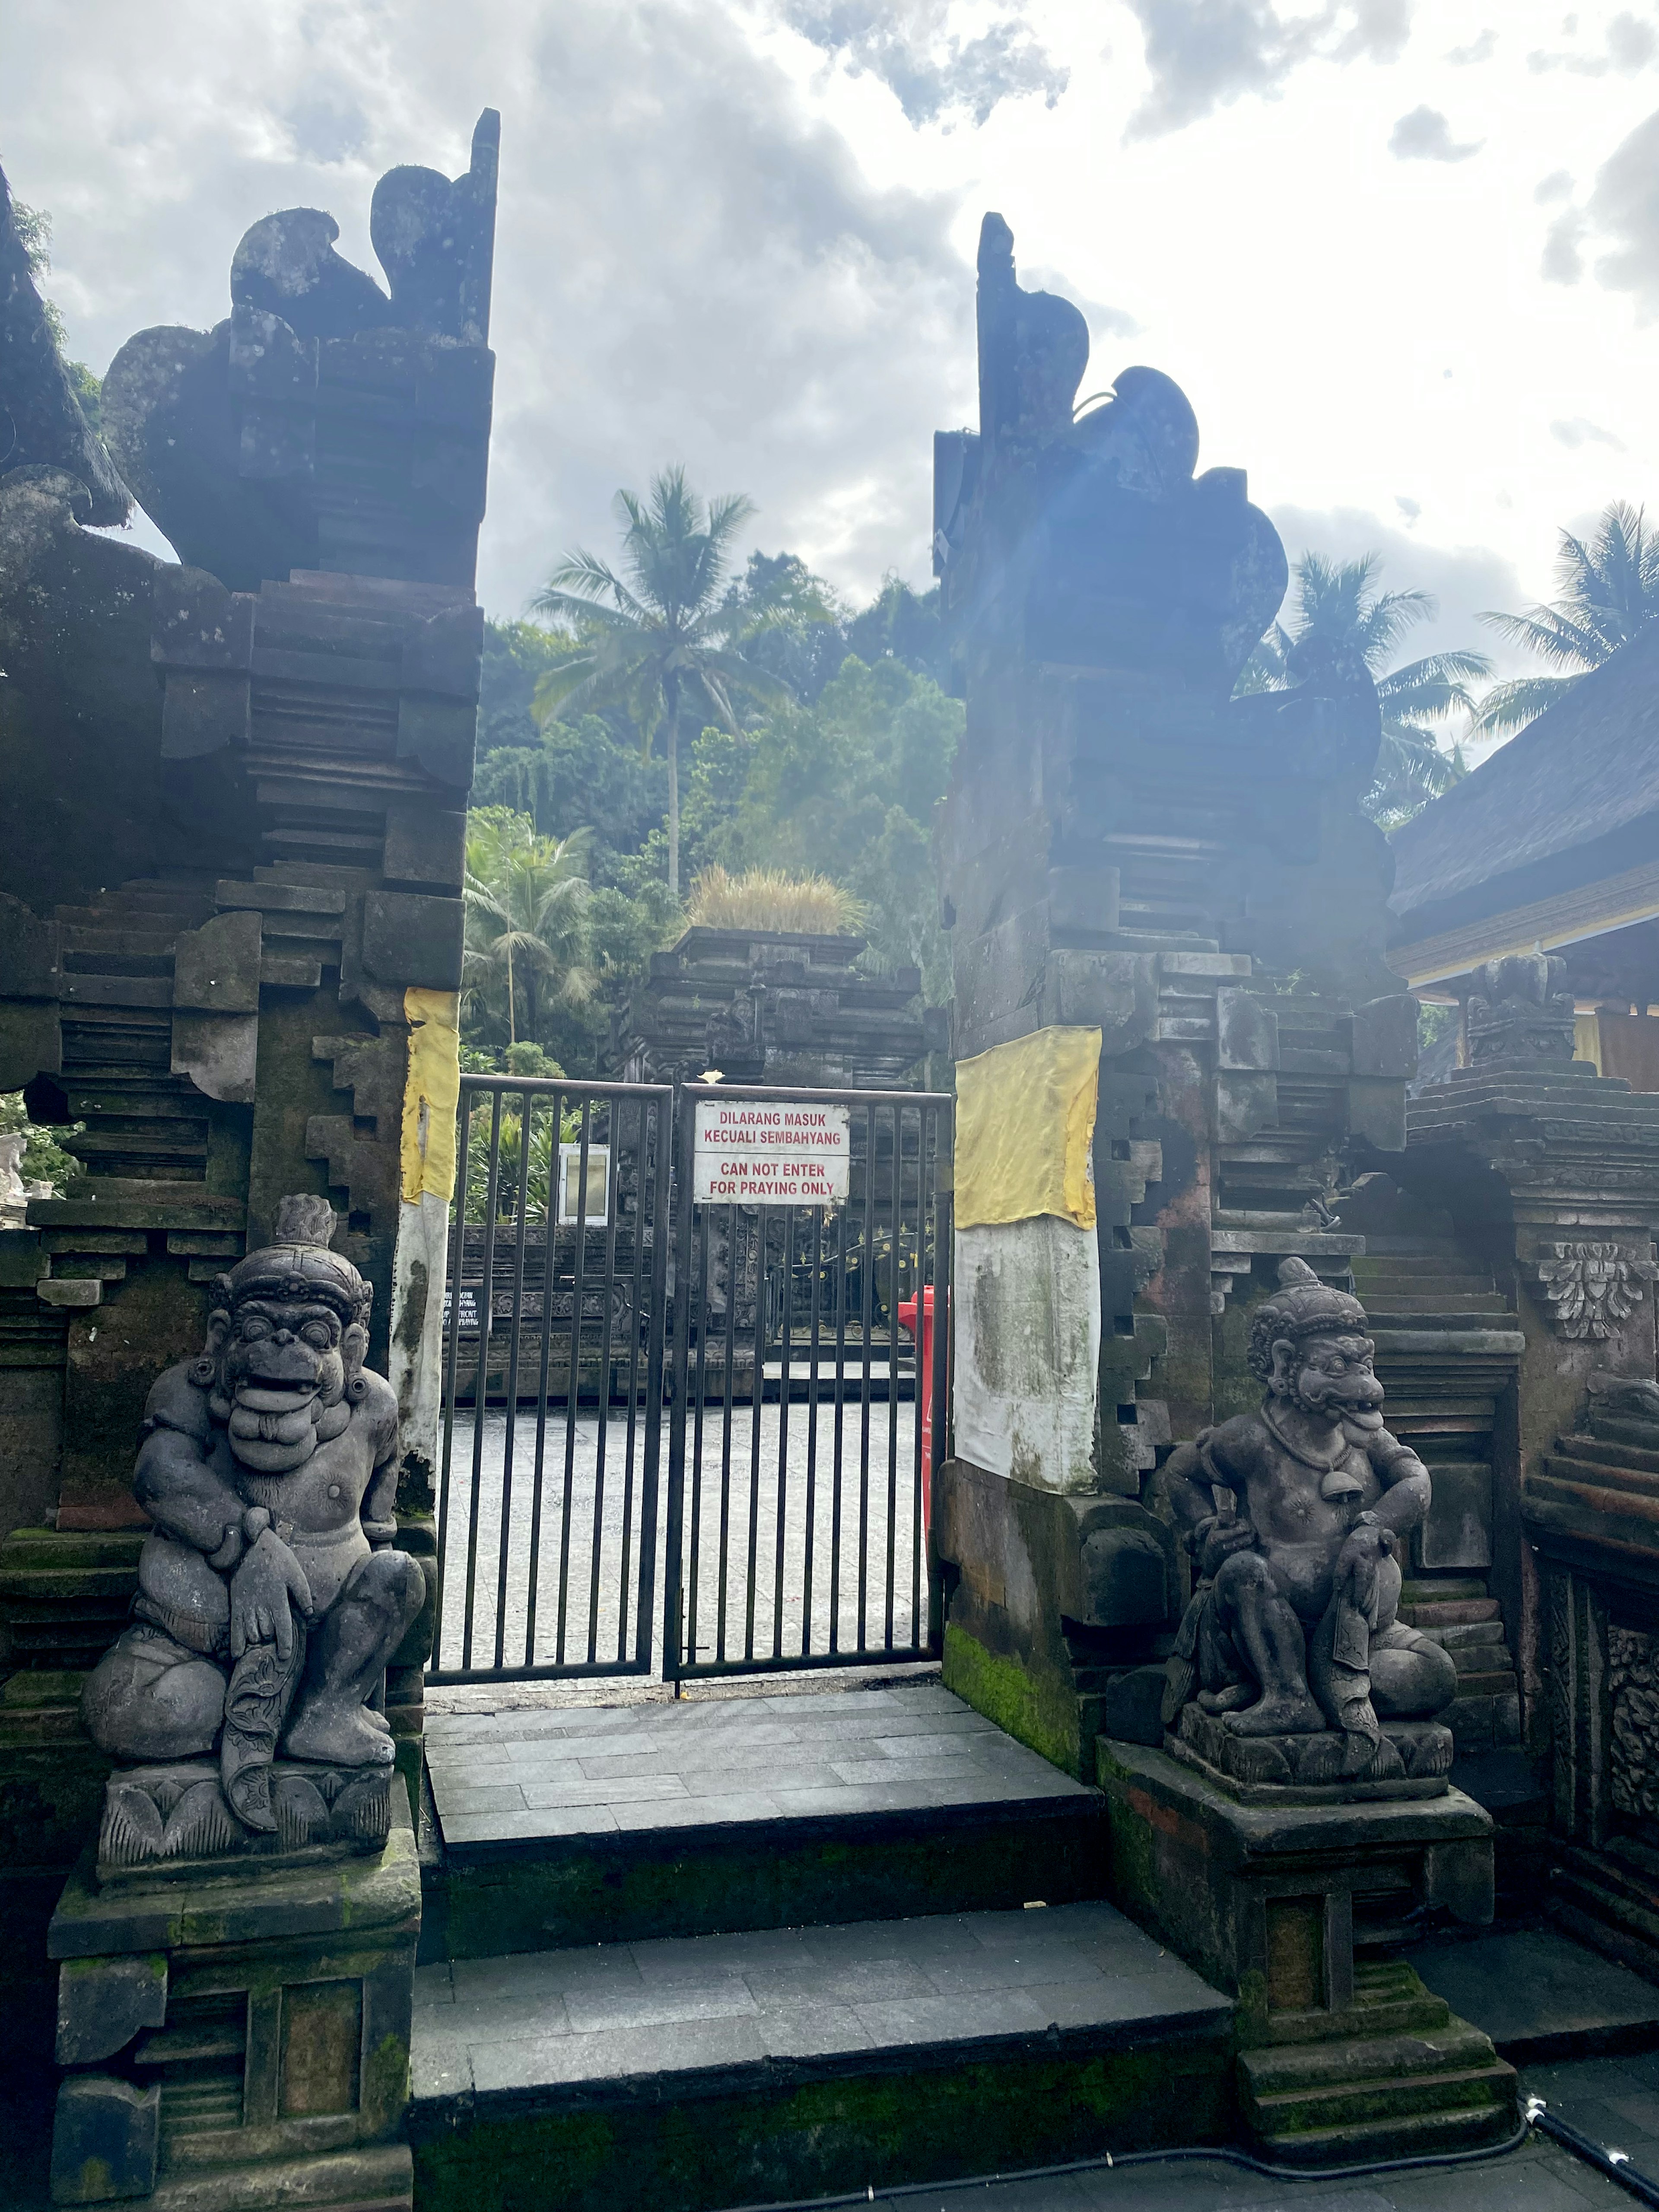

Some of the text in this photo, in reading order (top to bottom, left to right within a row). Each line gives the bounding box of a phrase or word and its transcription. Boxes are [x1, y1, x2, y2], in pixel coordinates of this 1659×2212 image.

[720, 1112, 826, 1126] DILARANG MASUK
[705, 1130, 840, 1144] KECUALI SEMBAHYANG
[721, 1163, 825, 1177] CAN NOT ENTER
[710, 1181, 834, 1195] FOR PRAYING ONLY
